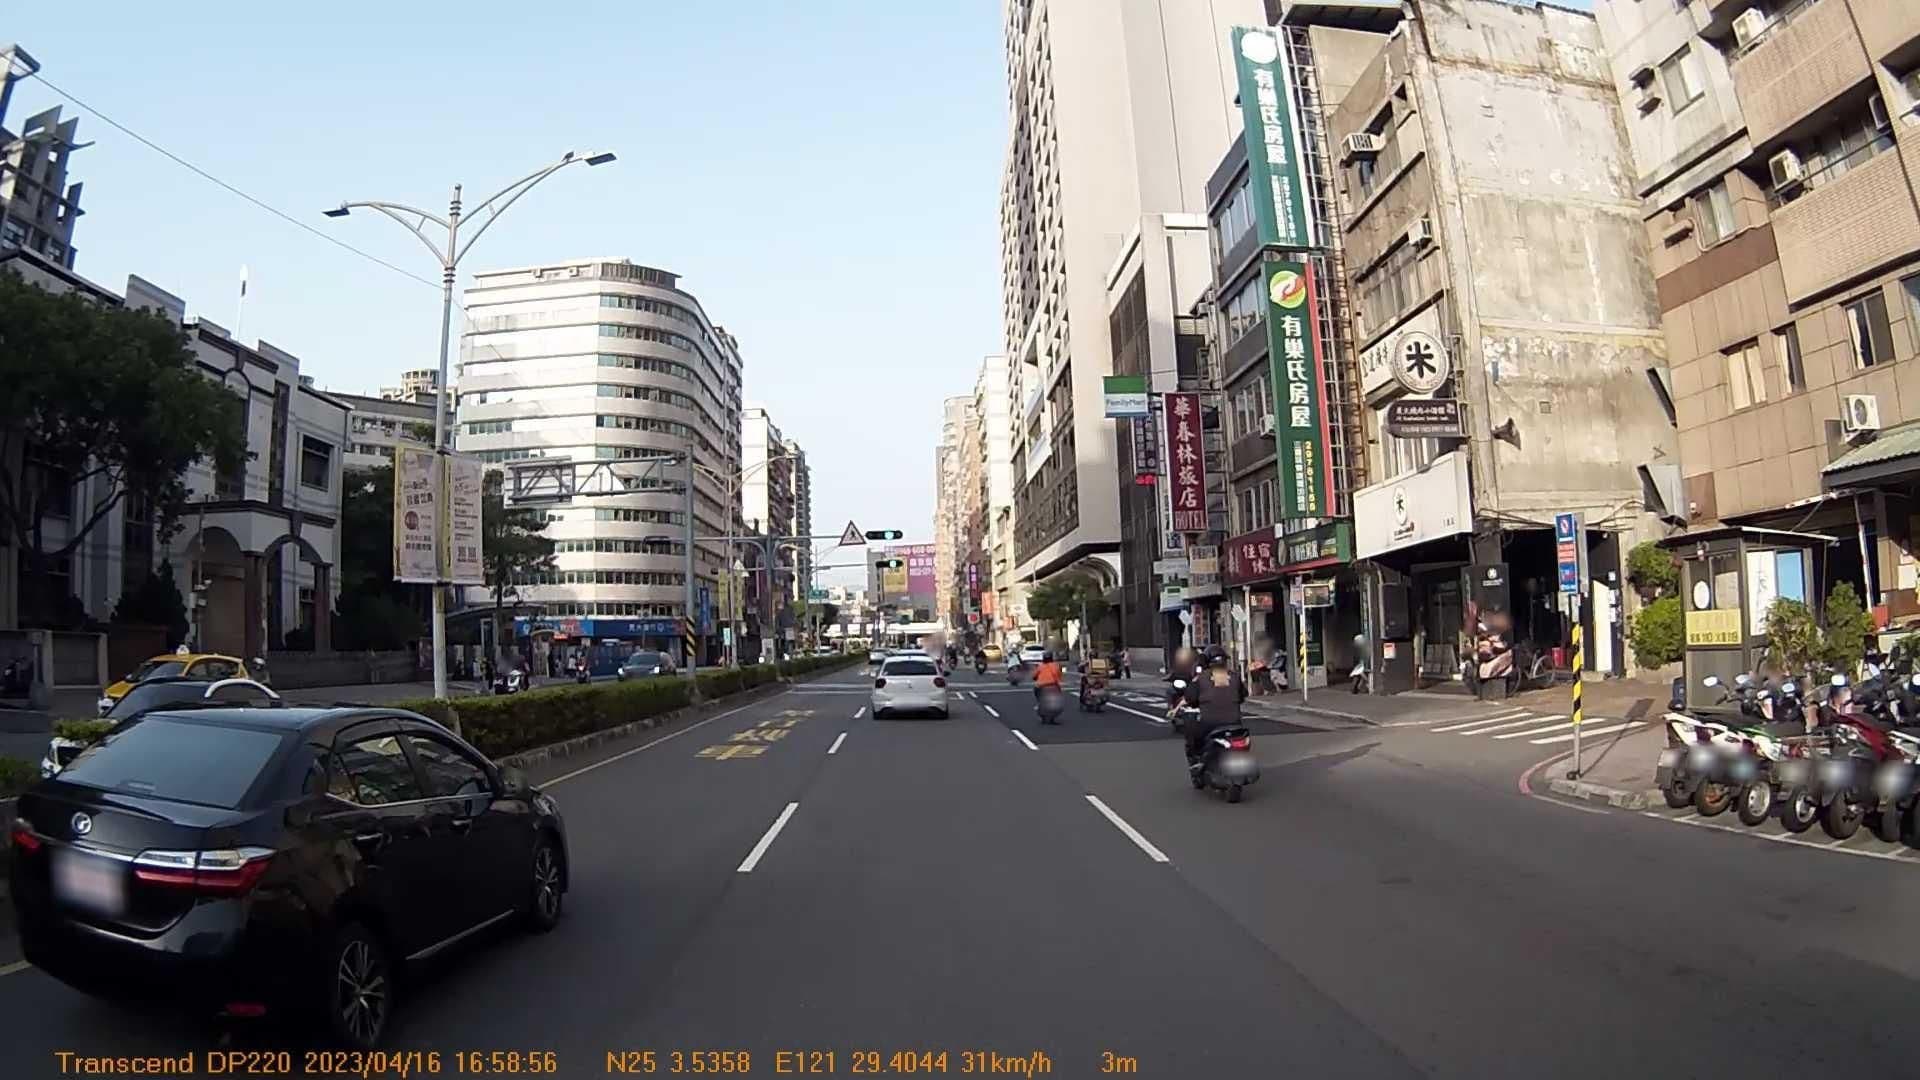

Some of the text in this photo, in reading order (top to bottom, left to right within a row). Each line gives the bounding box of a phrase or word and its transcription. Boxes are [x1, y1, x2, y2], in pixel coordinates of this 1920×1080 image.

[1252, 69, 1288, 164] 有巢氏房屋
[1280, 314, 1313, 428] 有巢氏房屋
[1405, 340, 1437, 379] 米
[1173, 396, 1200, 508] 華春林旅店
[1174, 510, 1207, 530] HOTEL
[1242, 543, 1271, 559] 住宿
